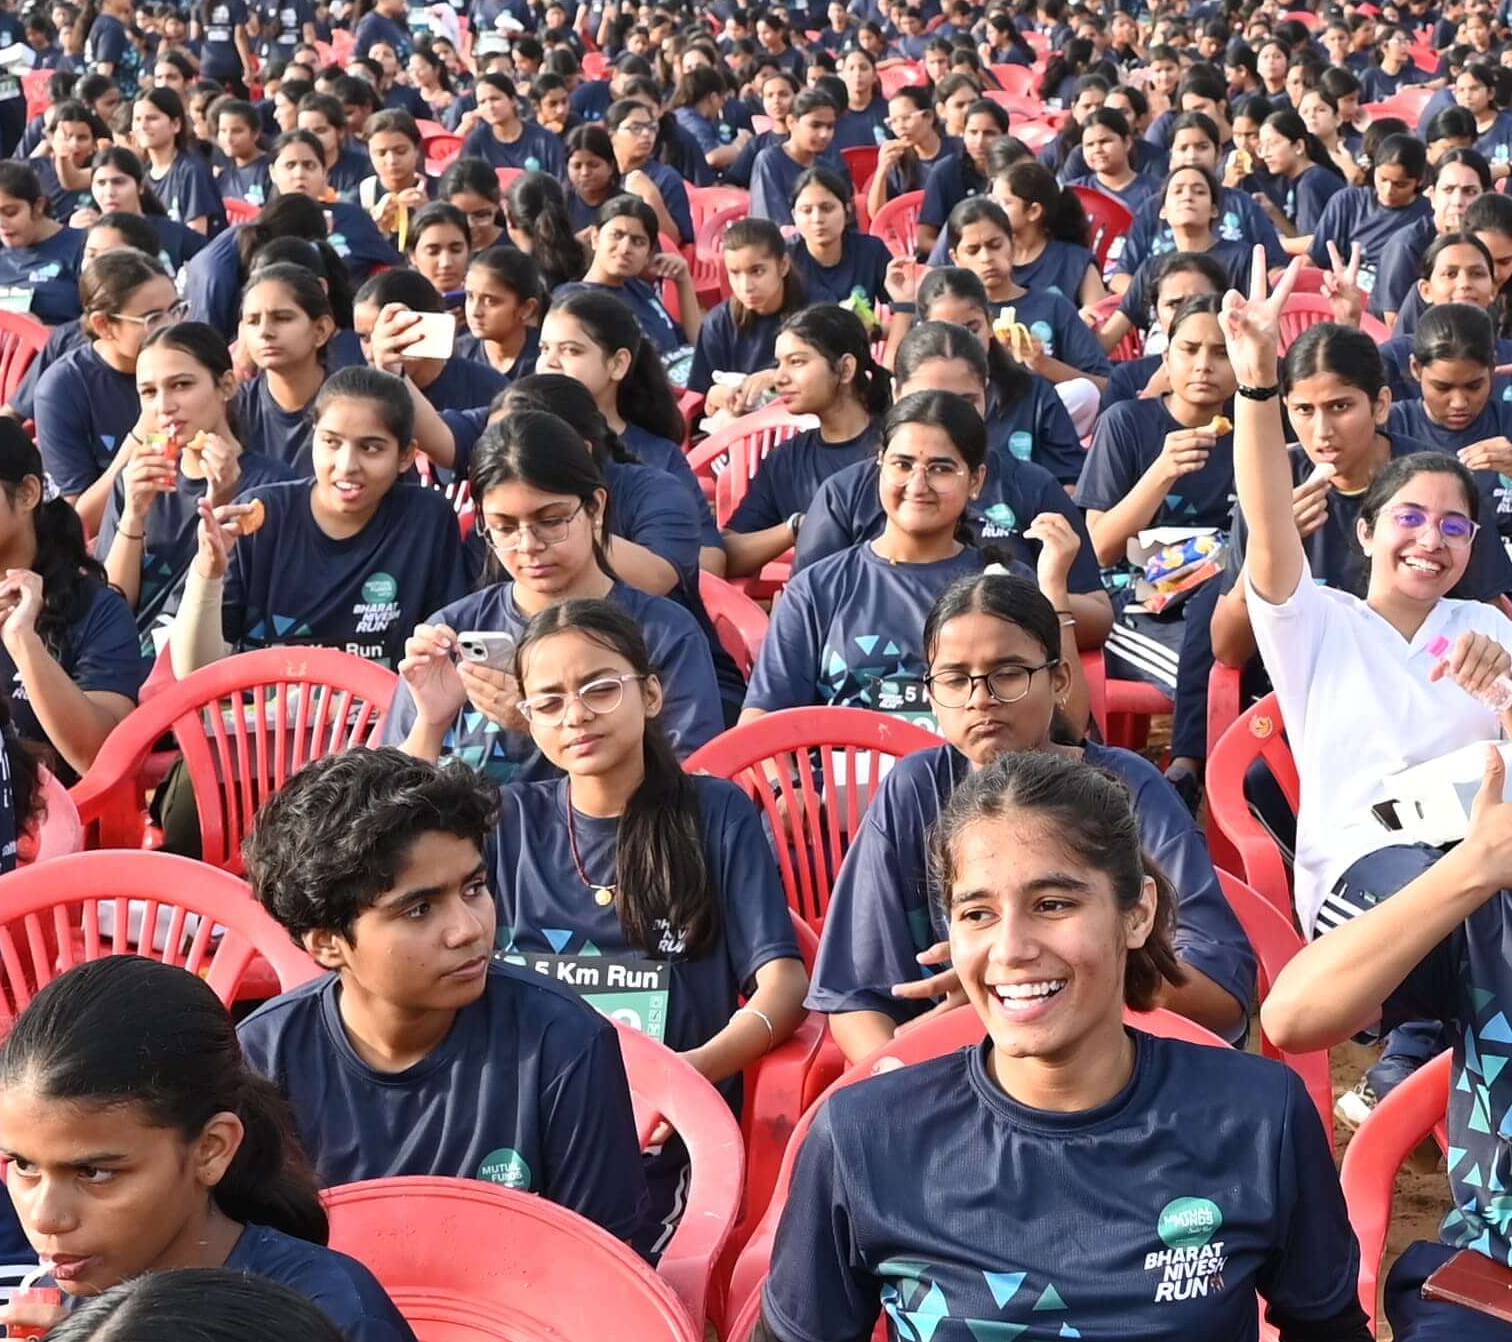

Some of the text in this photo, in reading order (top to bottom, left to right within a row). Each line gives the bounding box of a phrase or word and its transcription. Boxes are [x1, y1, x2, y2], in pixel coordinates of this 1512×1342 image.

[353, 602, 398, 615] BHARAT
[356, 621, 388, 633] RUN
[345, 642, 383, 658] Run
[905, 686, 916, 701] 5
[557, 961, 659, 990] Km Run
[1143, 1242, 1225, 1272] BHARAT
[1163, 1256, 1227, 1281] NIVESH
[1154, 1277, 1209, 1304] RUN
